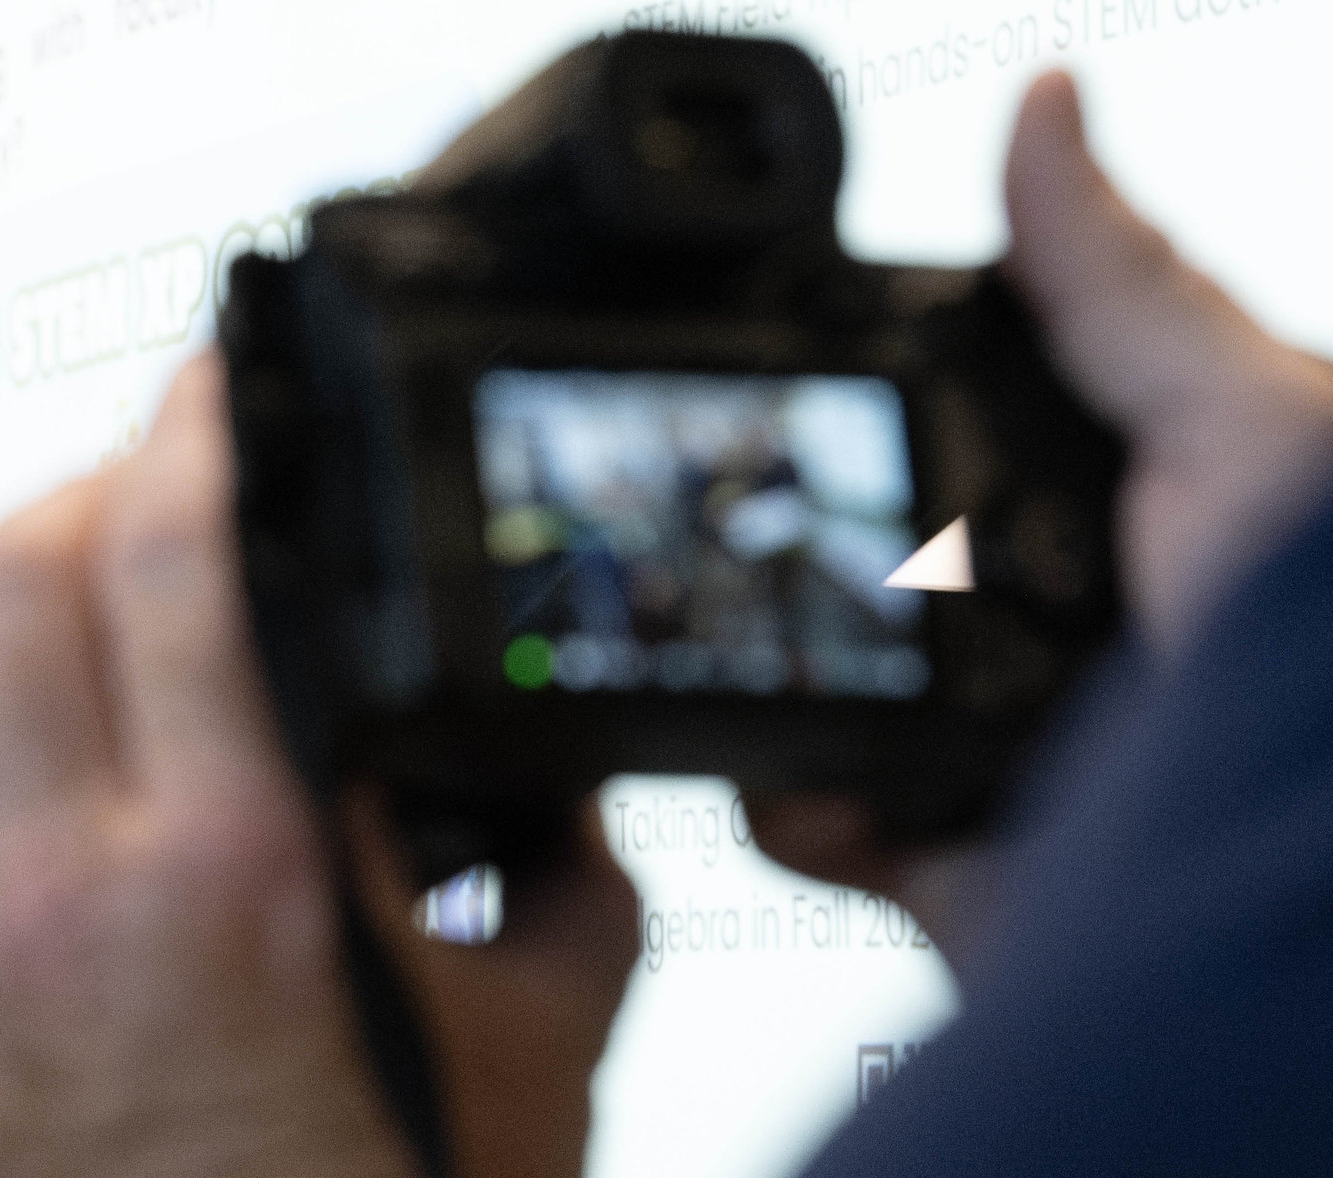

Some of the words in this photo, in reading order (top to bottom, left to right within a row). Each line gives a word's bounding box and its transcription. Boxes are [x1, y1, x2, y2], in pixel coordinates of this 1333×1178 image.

[857, 12, 1038, 106] hands-on
[616, 796, 720, 866] Taking
[750, 894, 782, 949] in
[792, 891, 850, 949] Fall
